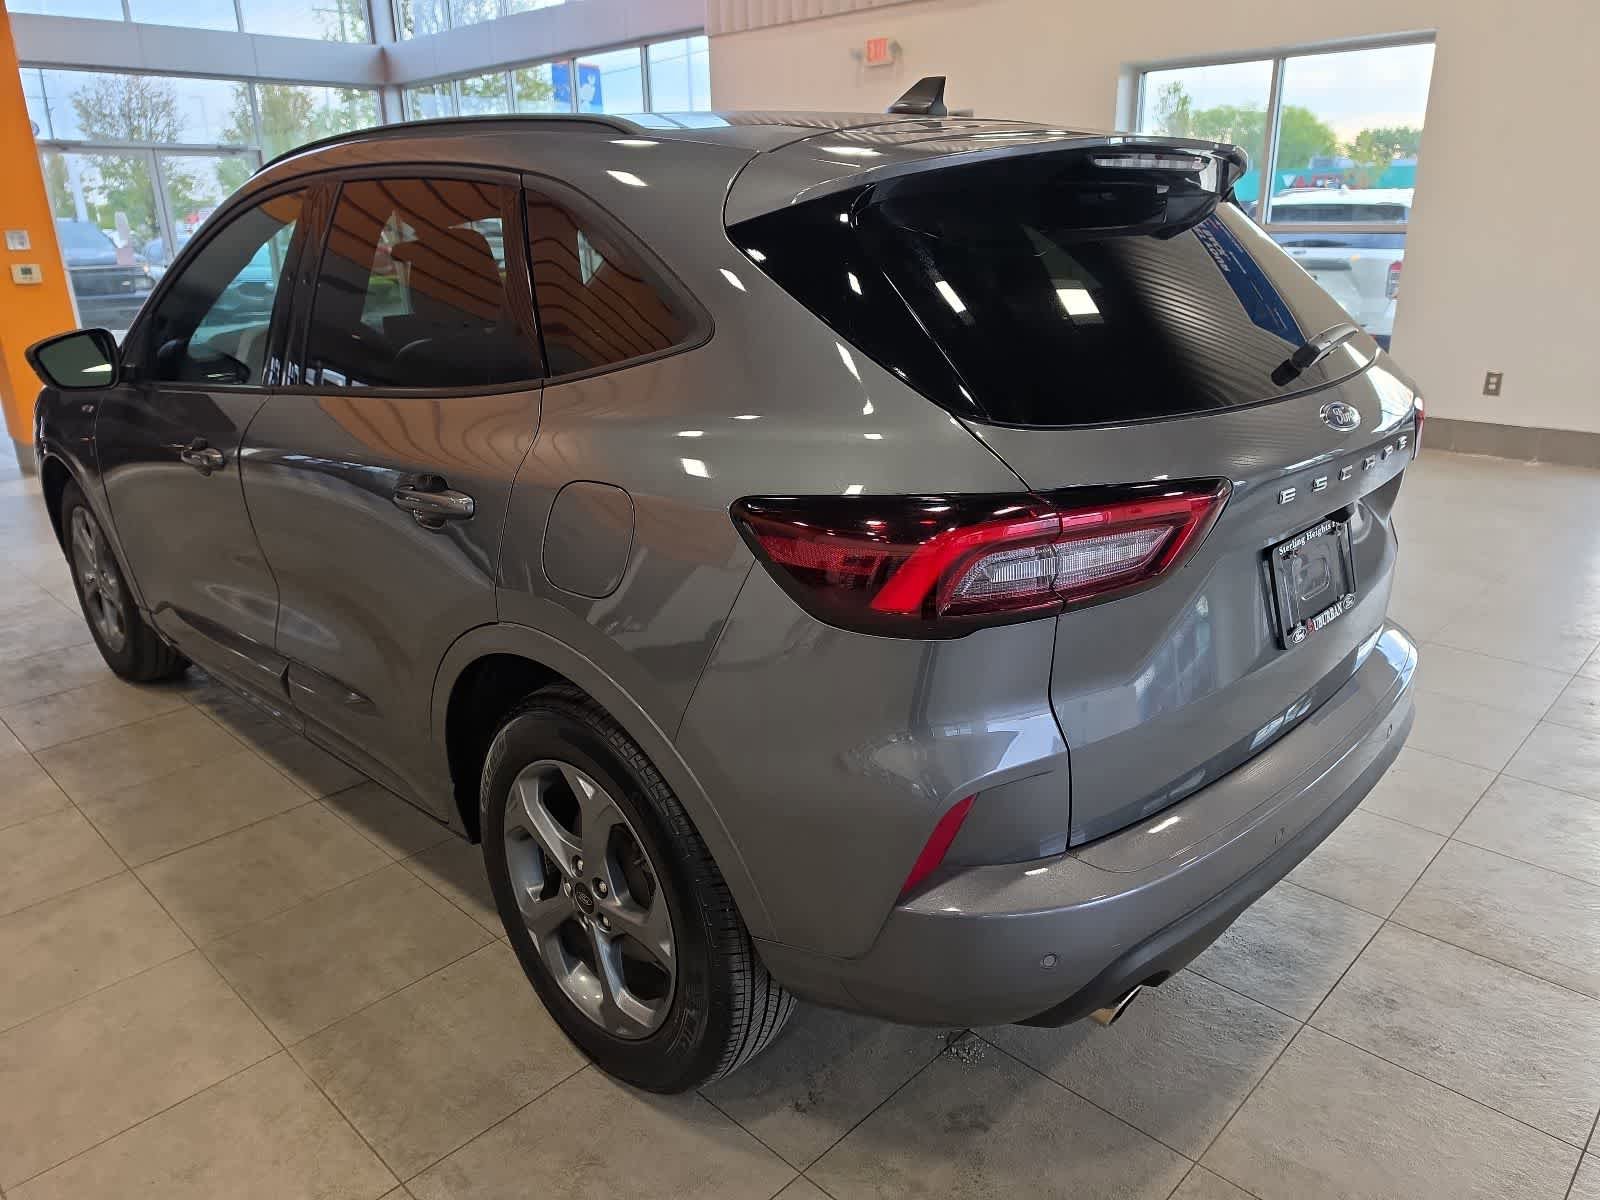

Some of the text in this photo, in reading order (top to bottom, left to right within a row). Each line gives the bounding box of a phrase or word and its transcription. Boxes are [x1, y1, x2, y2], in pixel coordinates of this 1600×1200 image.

[1278, 436, 1407, 504] ESCAPE
[1278, 536, 1306, 556] Sterling
[1305, 521, 1332, 541] Heights
[1306, 601, 1343, 632] SUBURBAN
